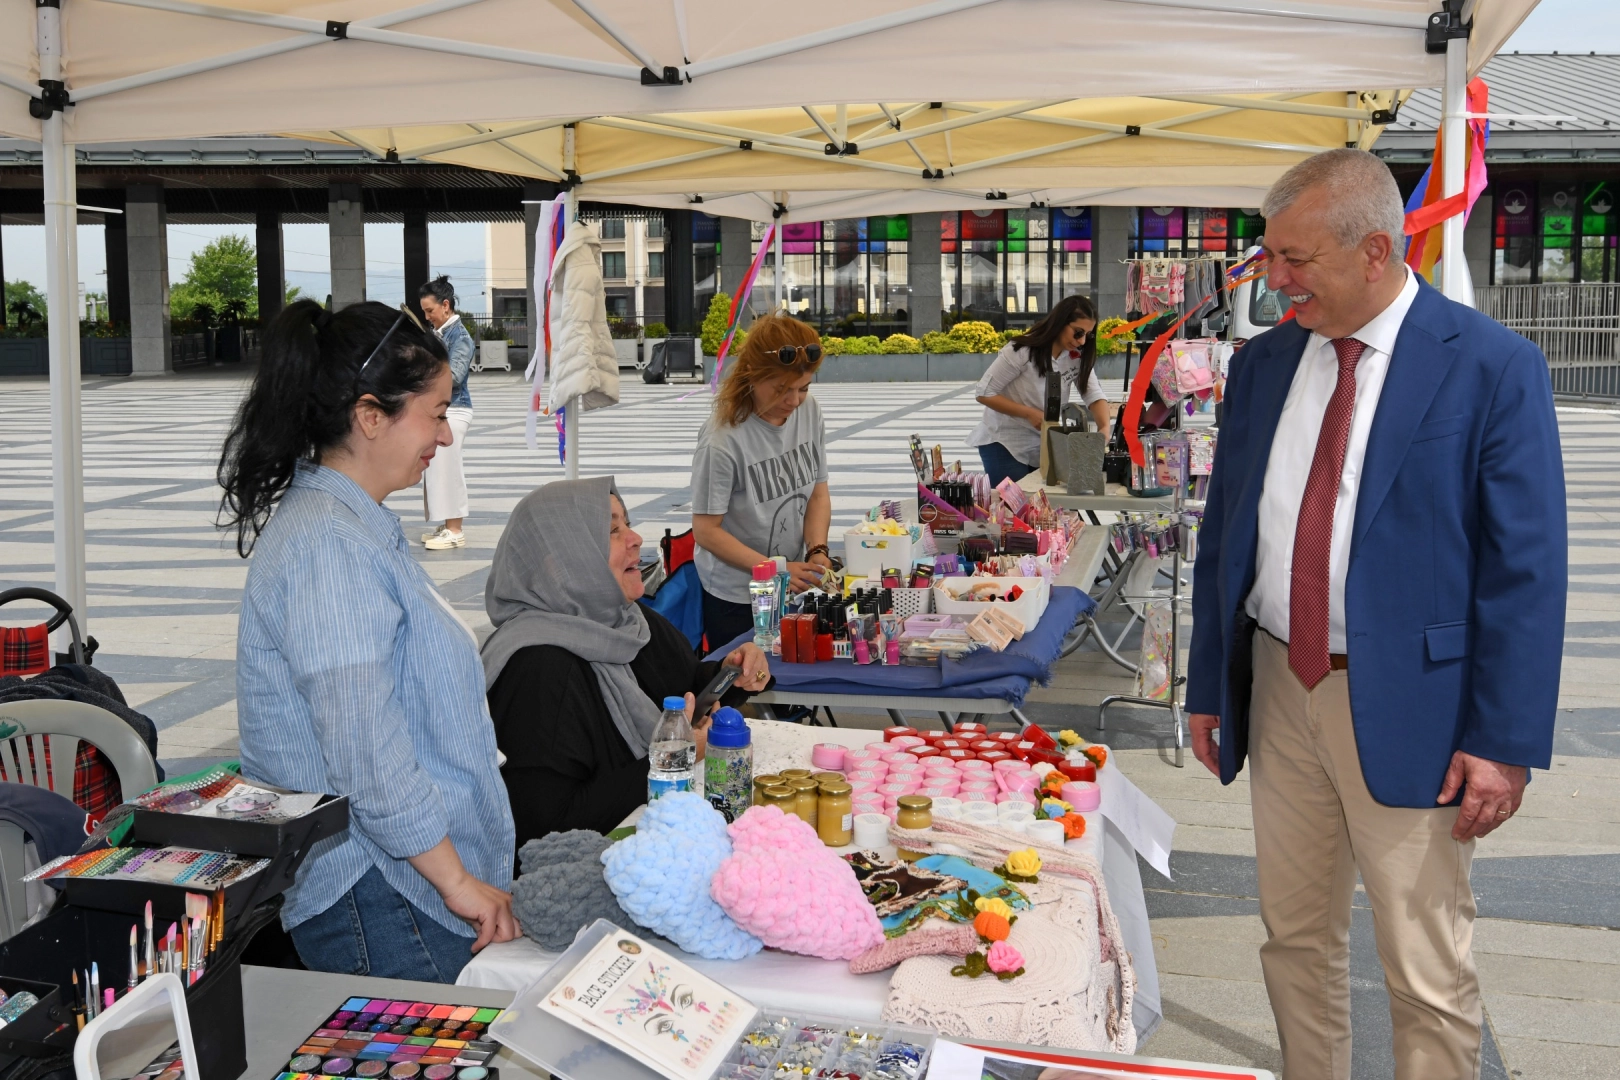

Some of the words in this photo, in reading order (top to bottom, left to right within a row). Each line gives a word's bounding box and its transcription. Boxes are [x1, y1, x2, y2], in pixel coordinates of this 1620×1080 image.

[747, 440, 820, 505] NIRVANA
[577, 982, 606, 1009] FACE
[597, 955, 637, 987] STICKER
